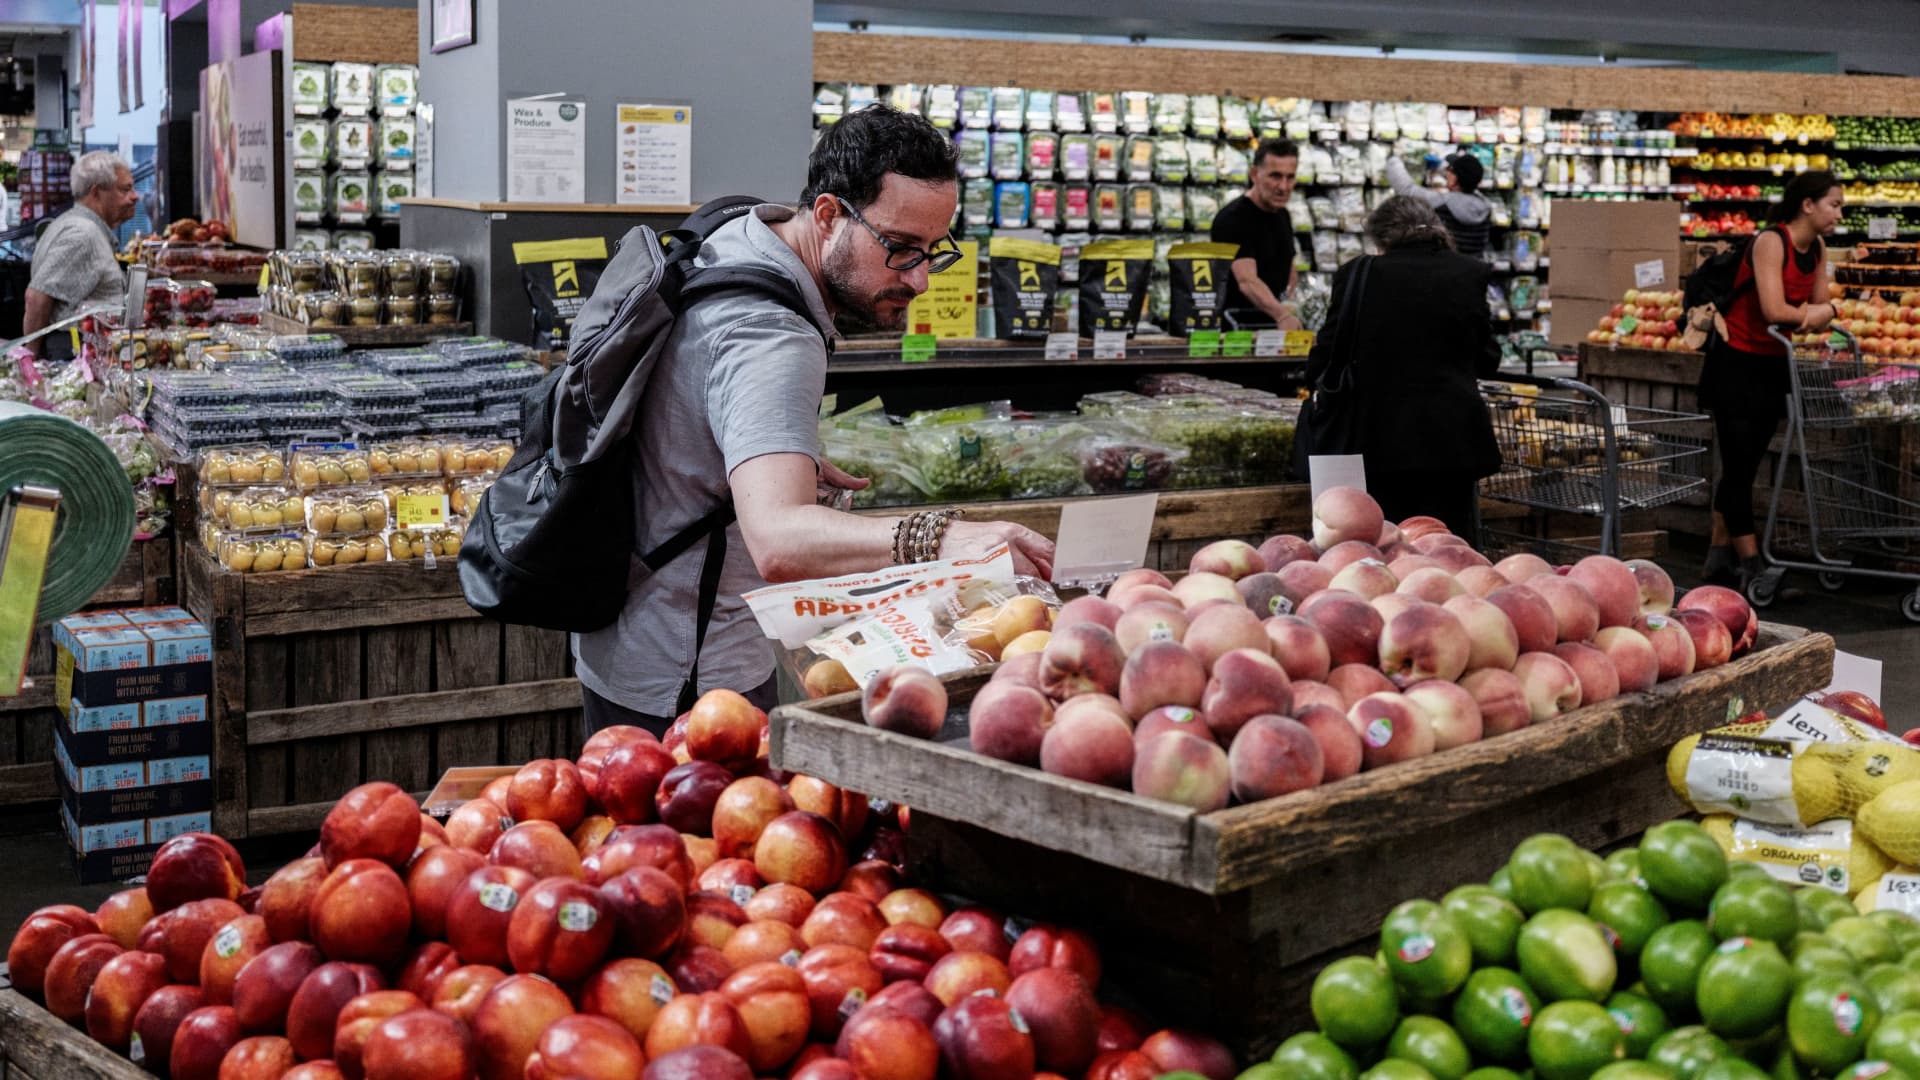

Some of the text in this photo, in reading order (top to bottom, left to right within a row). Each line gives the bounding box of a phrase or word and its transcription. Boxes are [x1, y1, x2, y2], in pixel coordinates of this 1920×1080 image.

[514, 107, 544, 117] Wax &
[514, 117, 552, 127] Produce
[827, 579, 868, 588] TANGY
[116, 676, 138, 687] FROM
[116, 687, 135, 697] WITH
[108, 734, 130, 745] FROM
[108, 745, 127, 755] WITH
[1718, 778, 1759, 792] GREEN
[112, 793, 133, 804] FROM
[112, 803, 130, 813] WITH
[112, 852, 155, 866] FROM MAIN
[1760, 848, 1820, 863] ORGANIC
[112, 865, 130, 876] WITH
